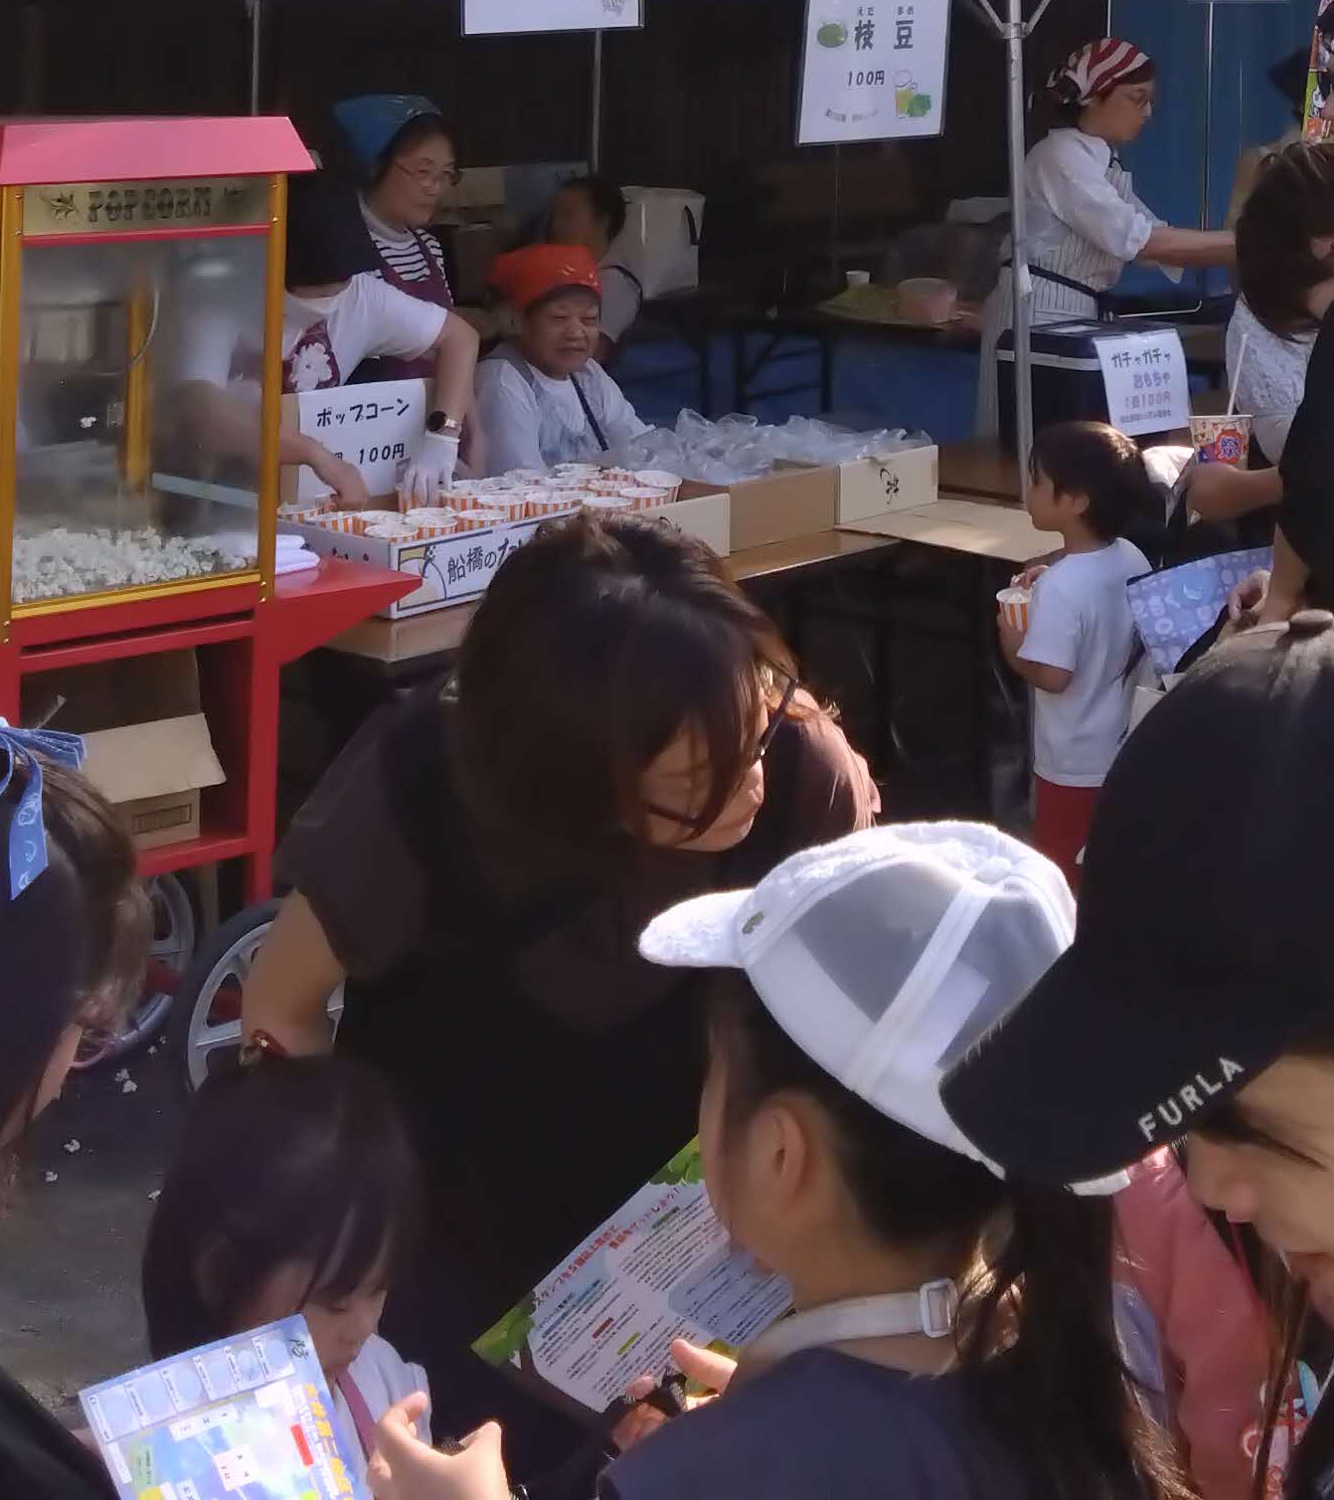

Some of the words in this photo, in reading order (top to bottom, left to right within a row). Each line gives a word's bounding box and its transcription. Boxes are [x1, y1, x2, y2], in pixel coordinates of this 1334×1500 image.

[847, 70, 885, 87] 100円
[88, 187, 213, 223] POPCORN
[317, 398, 410, 427] ポップコーン
[358, 443, 405, 465] 100円
[1138, 1057, 1245, 1142] FURLA
